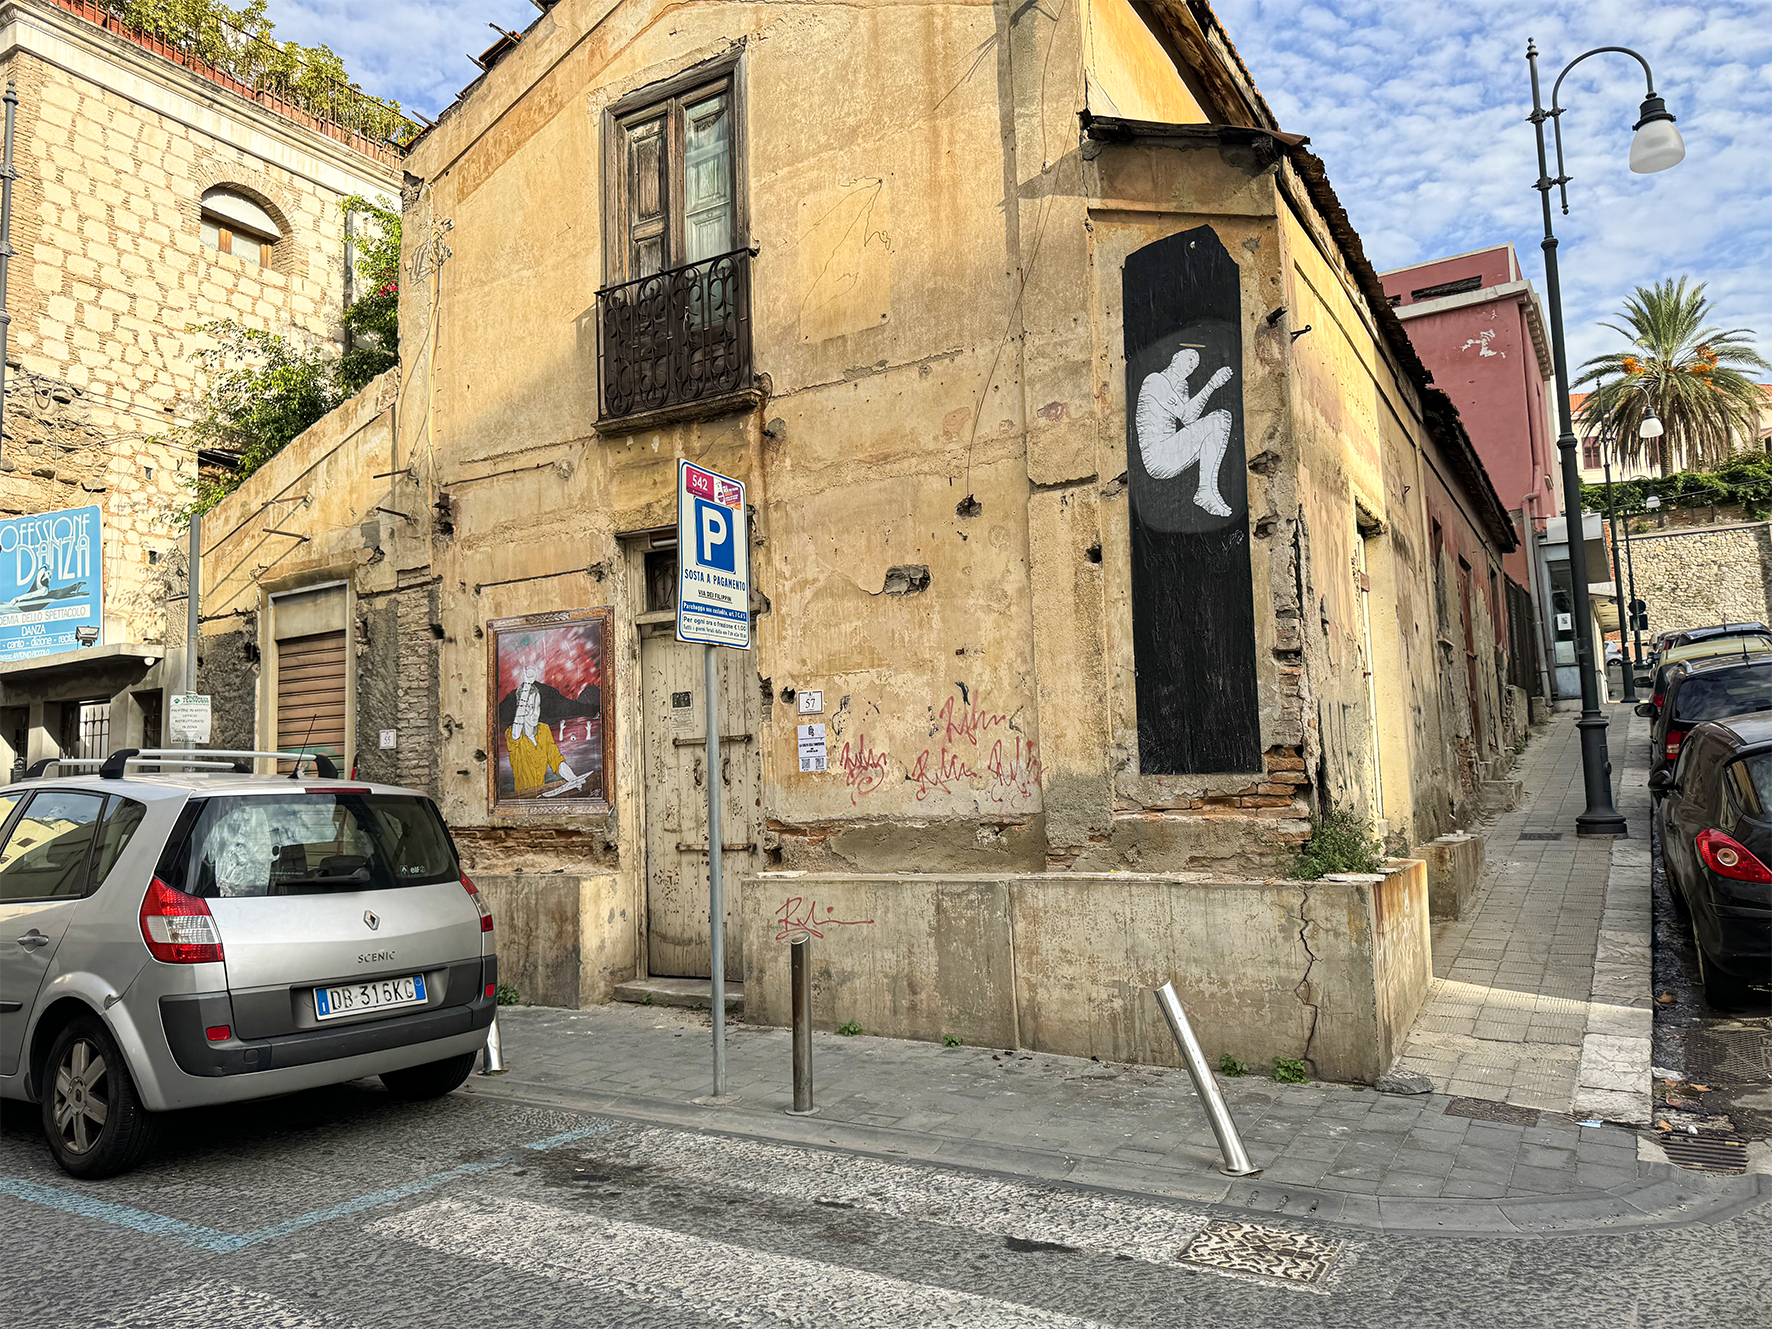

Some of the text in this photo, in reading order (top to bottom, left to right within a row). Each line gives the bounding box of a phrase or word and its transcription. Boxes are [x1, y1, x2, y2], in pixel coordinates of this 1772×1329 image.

[692, 474, 708, 491] 542
[702, 506, 727, 561] P
[17, 534, 90, 586] DANZA
[684, 568, 746, 591] SOSTA A PAGAMENTO
[21, 611, 43, 623] DELLO
[44, 606, 86, 620] SPETTACOLO
[683, 615, 693, 623] Per
[21, 624, 46, 636] DANZA
[7, 639, 25, 649] canto
[31, 635, 52, 647] dizione
[805, 697, 816, 709] 57
[357, 950, 396, 964] SCENIC
[330, 987, 354, 1011] DB
